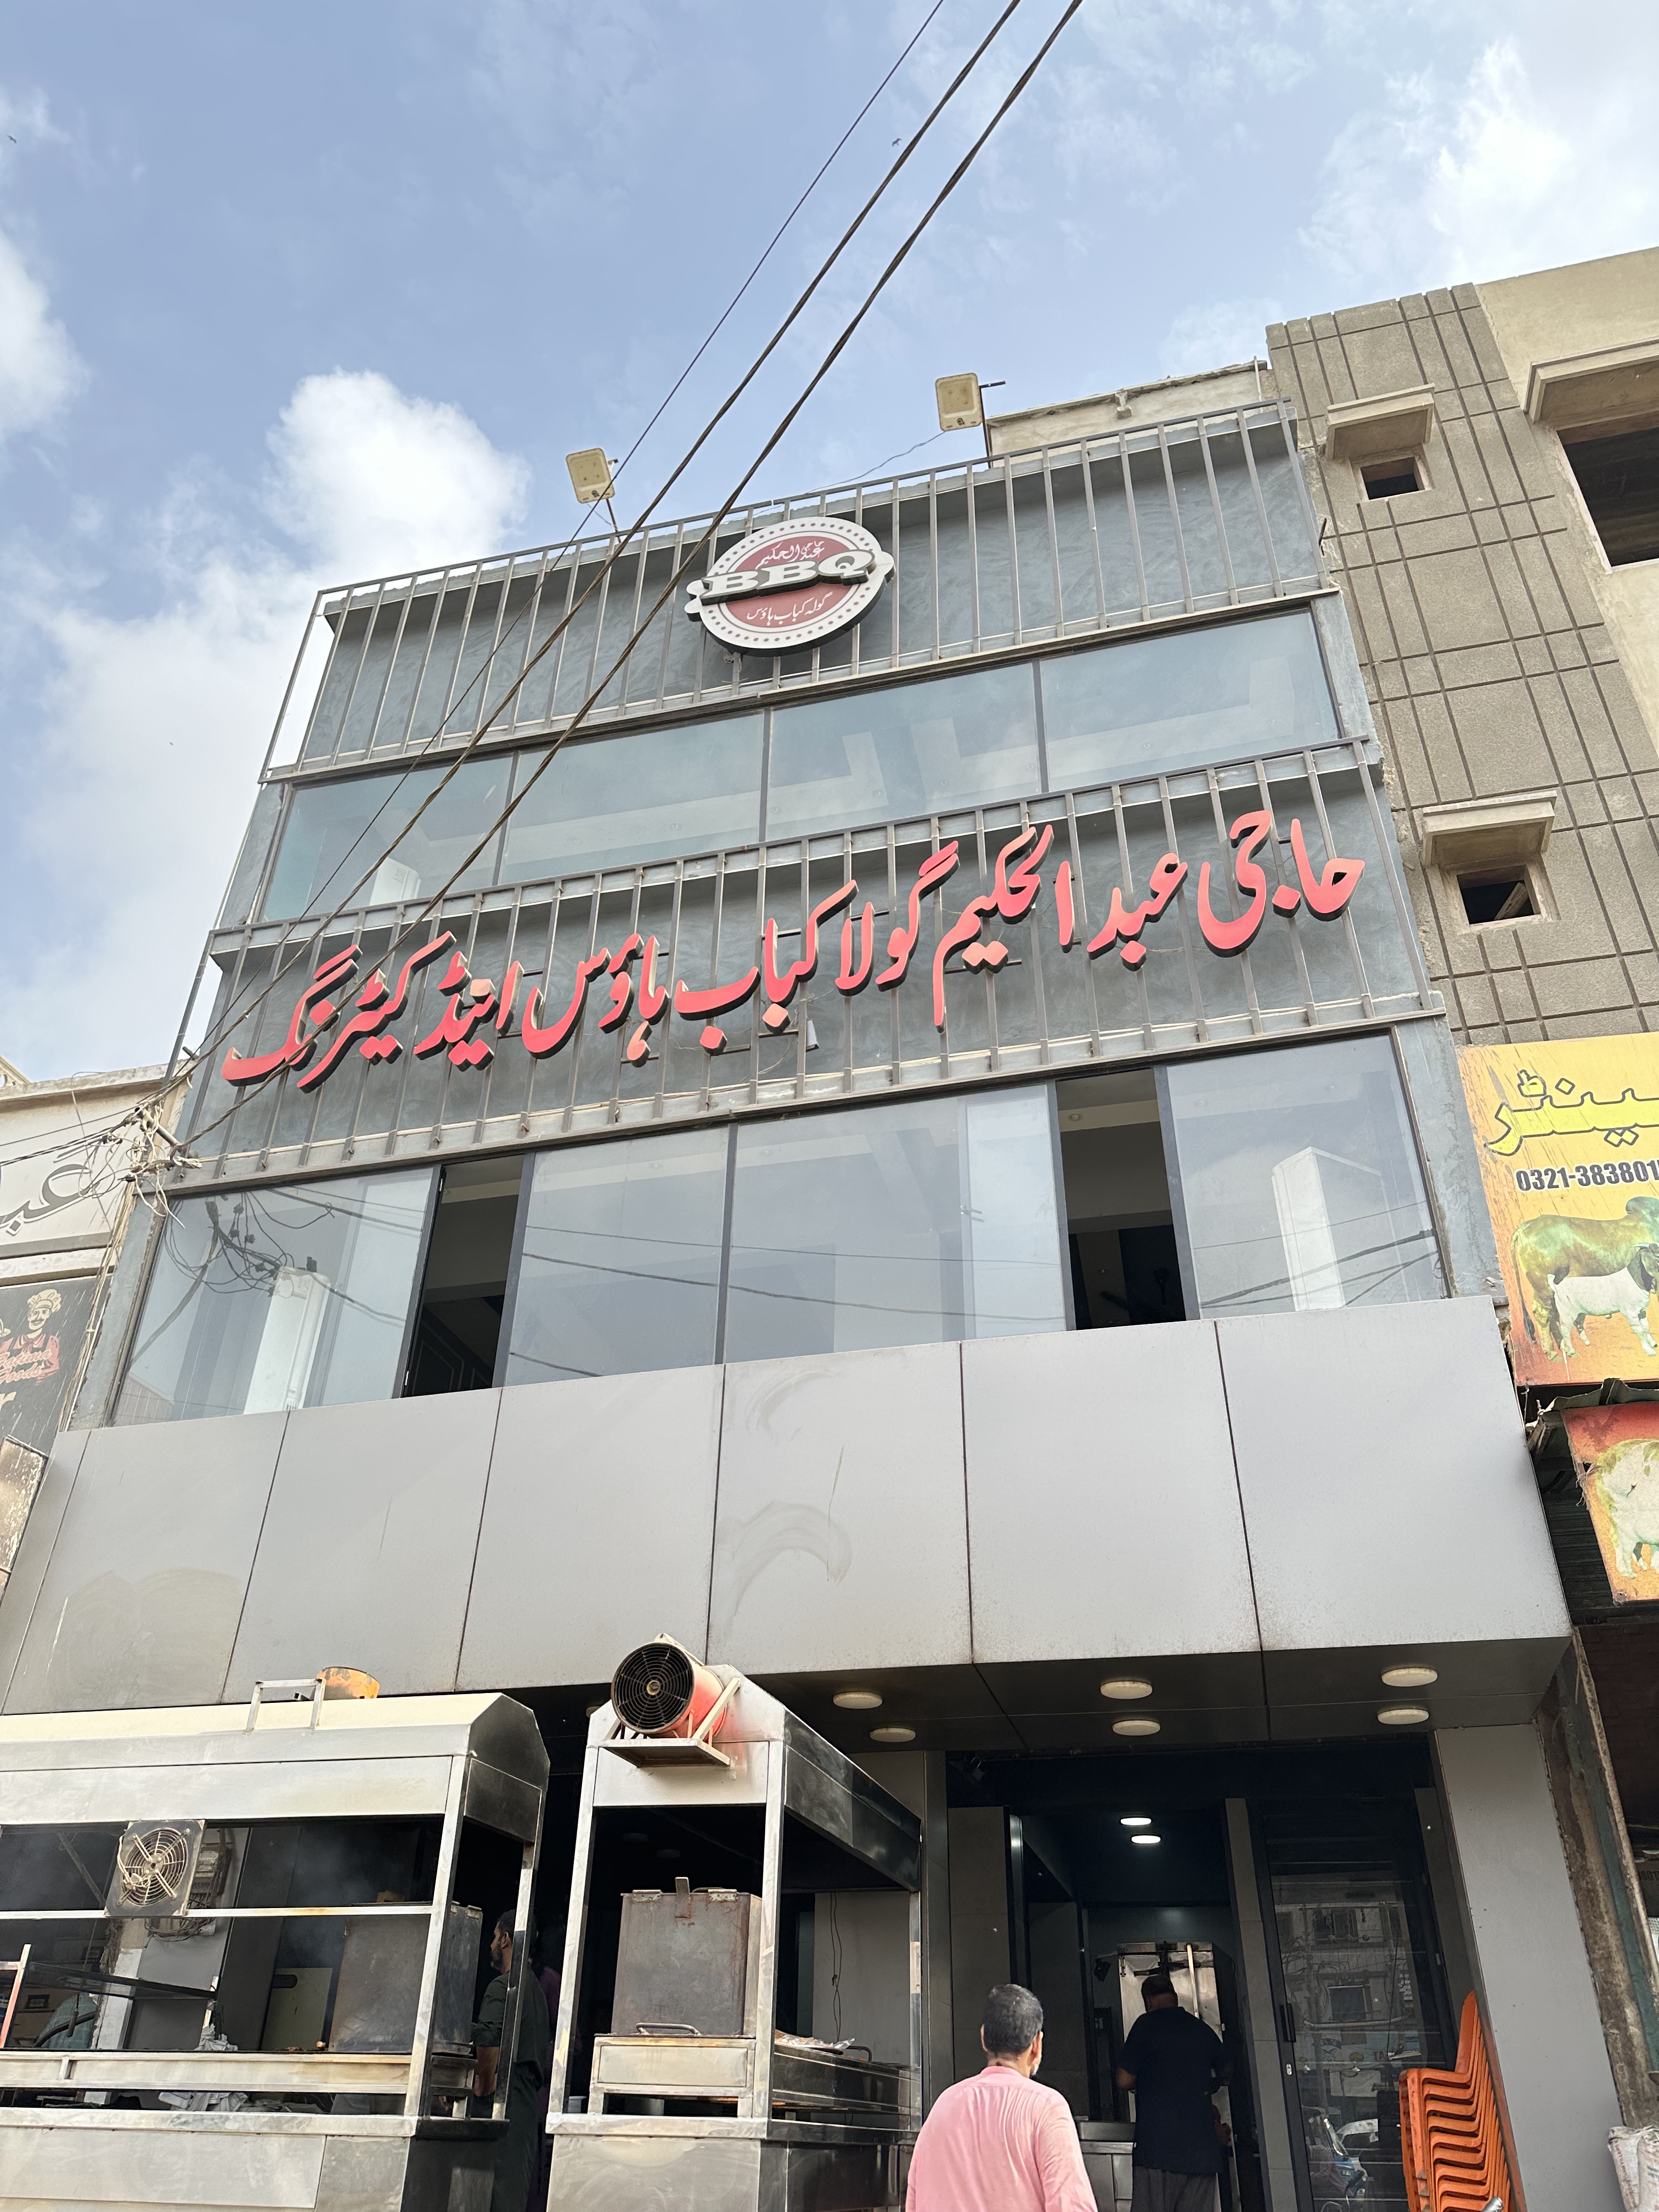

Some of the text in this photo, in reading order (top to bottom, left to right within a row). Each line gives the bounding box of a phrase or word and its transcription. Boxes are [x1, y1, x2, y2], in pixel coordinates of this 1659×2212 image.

[700, 550, 876, 600] BBQ
[774, 597, 815, 625] کباب
[834, 840, 959, 990] گولا
[1198, 810, 1366, 951] حاجی
[221, 930, 456, 1088] کیٹرنگ
[414, 951, 520, 1066] اینڈ
[521, 933, 665, 1062] ہاؤس
[674, 879, 857, 1050] کباب
[1516, 1159, 1659, 1191] 0321-383801
